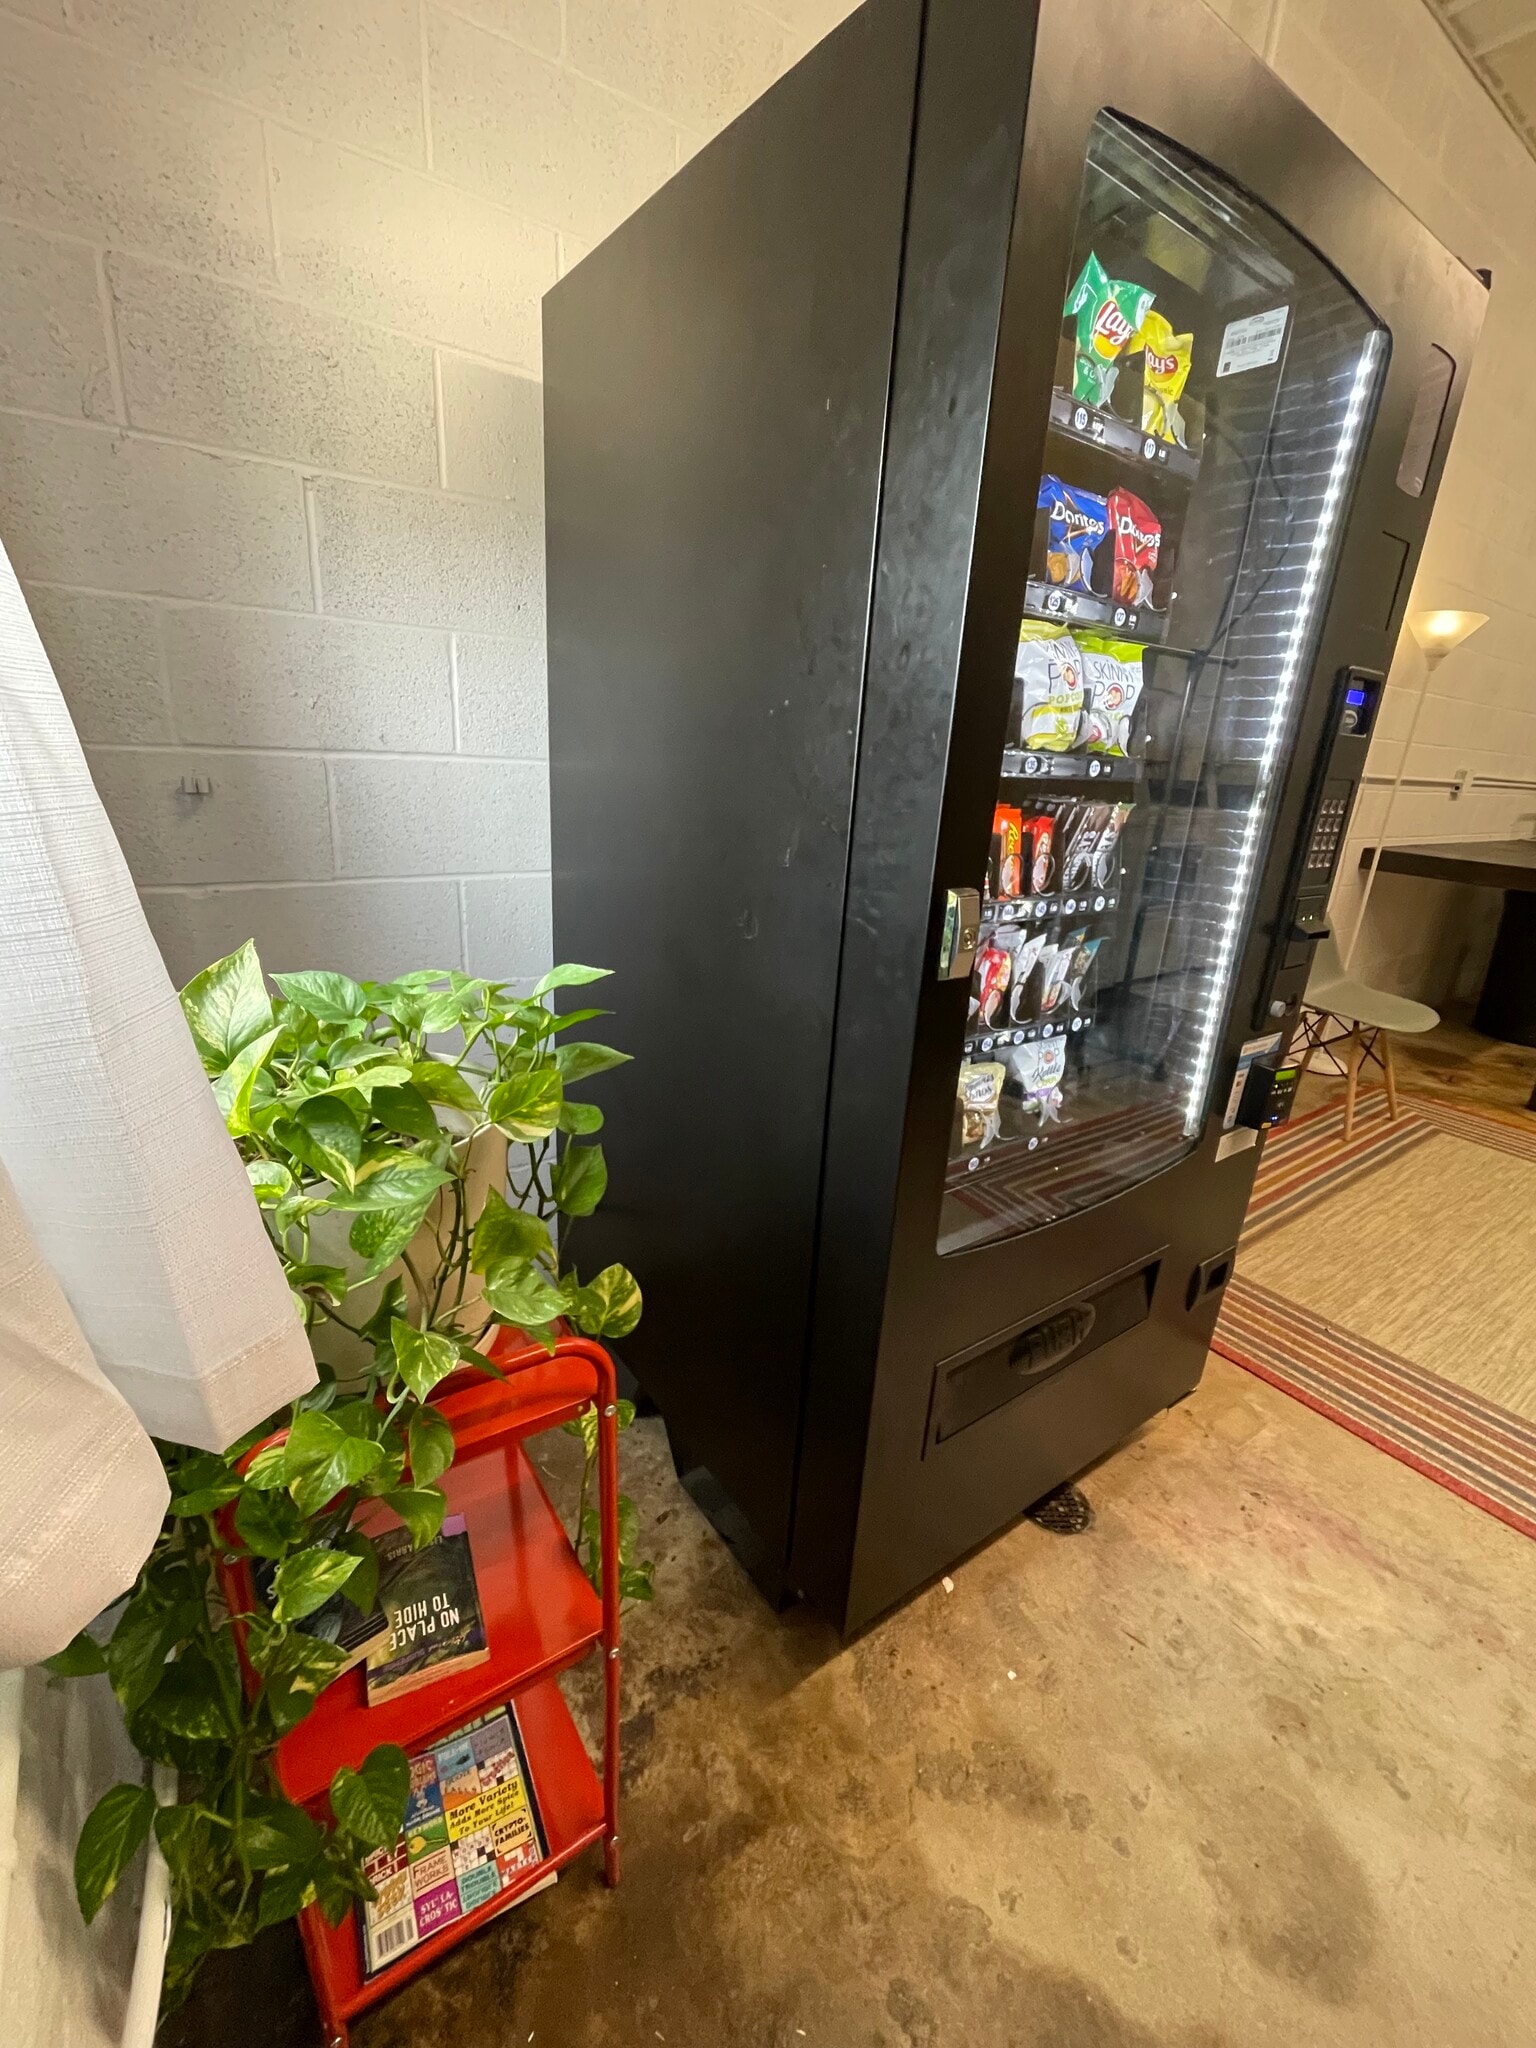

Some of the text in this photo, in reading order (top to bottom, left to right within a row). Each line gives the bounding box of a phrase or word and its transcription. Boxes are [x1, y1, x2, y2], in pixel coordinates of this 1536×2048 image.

[1050, 501, 1105, 534] Doritos
[1120, 516, 1161, 548] Doritos
[1091, 680, 1136, 711] POP
[388, 1543, 413, 1561] ARRIS
[394, 1592, 451, 1629] TO HIDE
[441, 1607, 460, 1628] NO
[389, 1616, 436, 1652] PLACE
[449, 1802, 476, 1820] More
[478, 1780, 518, 1805] Variety
[450, 1815, 471, 1829] Adds
[474, 1803, 495, 1817] More
[496, 1790, 519, 1806] Spice
[458, 1801, 514, 1836] To Your Life!
[494, 1816, 527, 1837] CRYPTO-
[495, 1823, 530, 1846] FAMILIES
[413, 1855, 447, 1880] FRAME
[414, 1864, 449, 1888] WORKS
